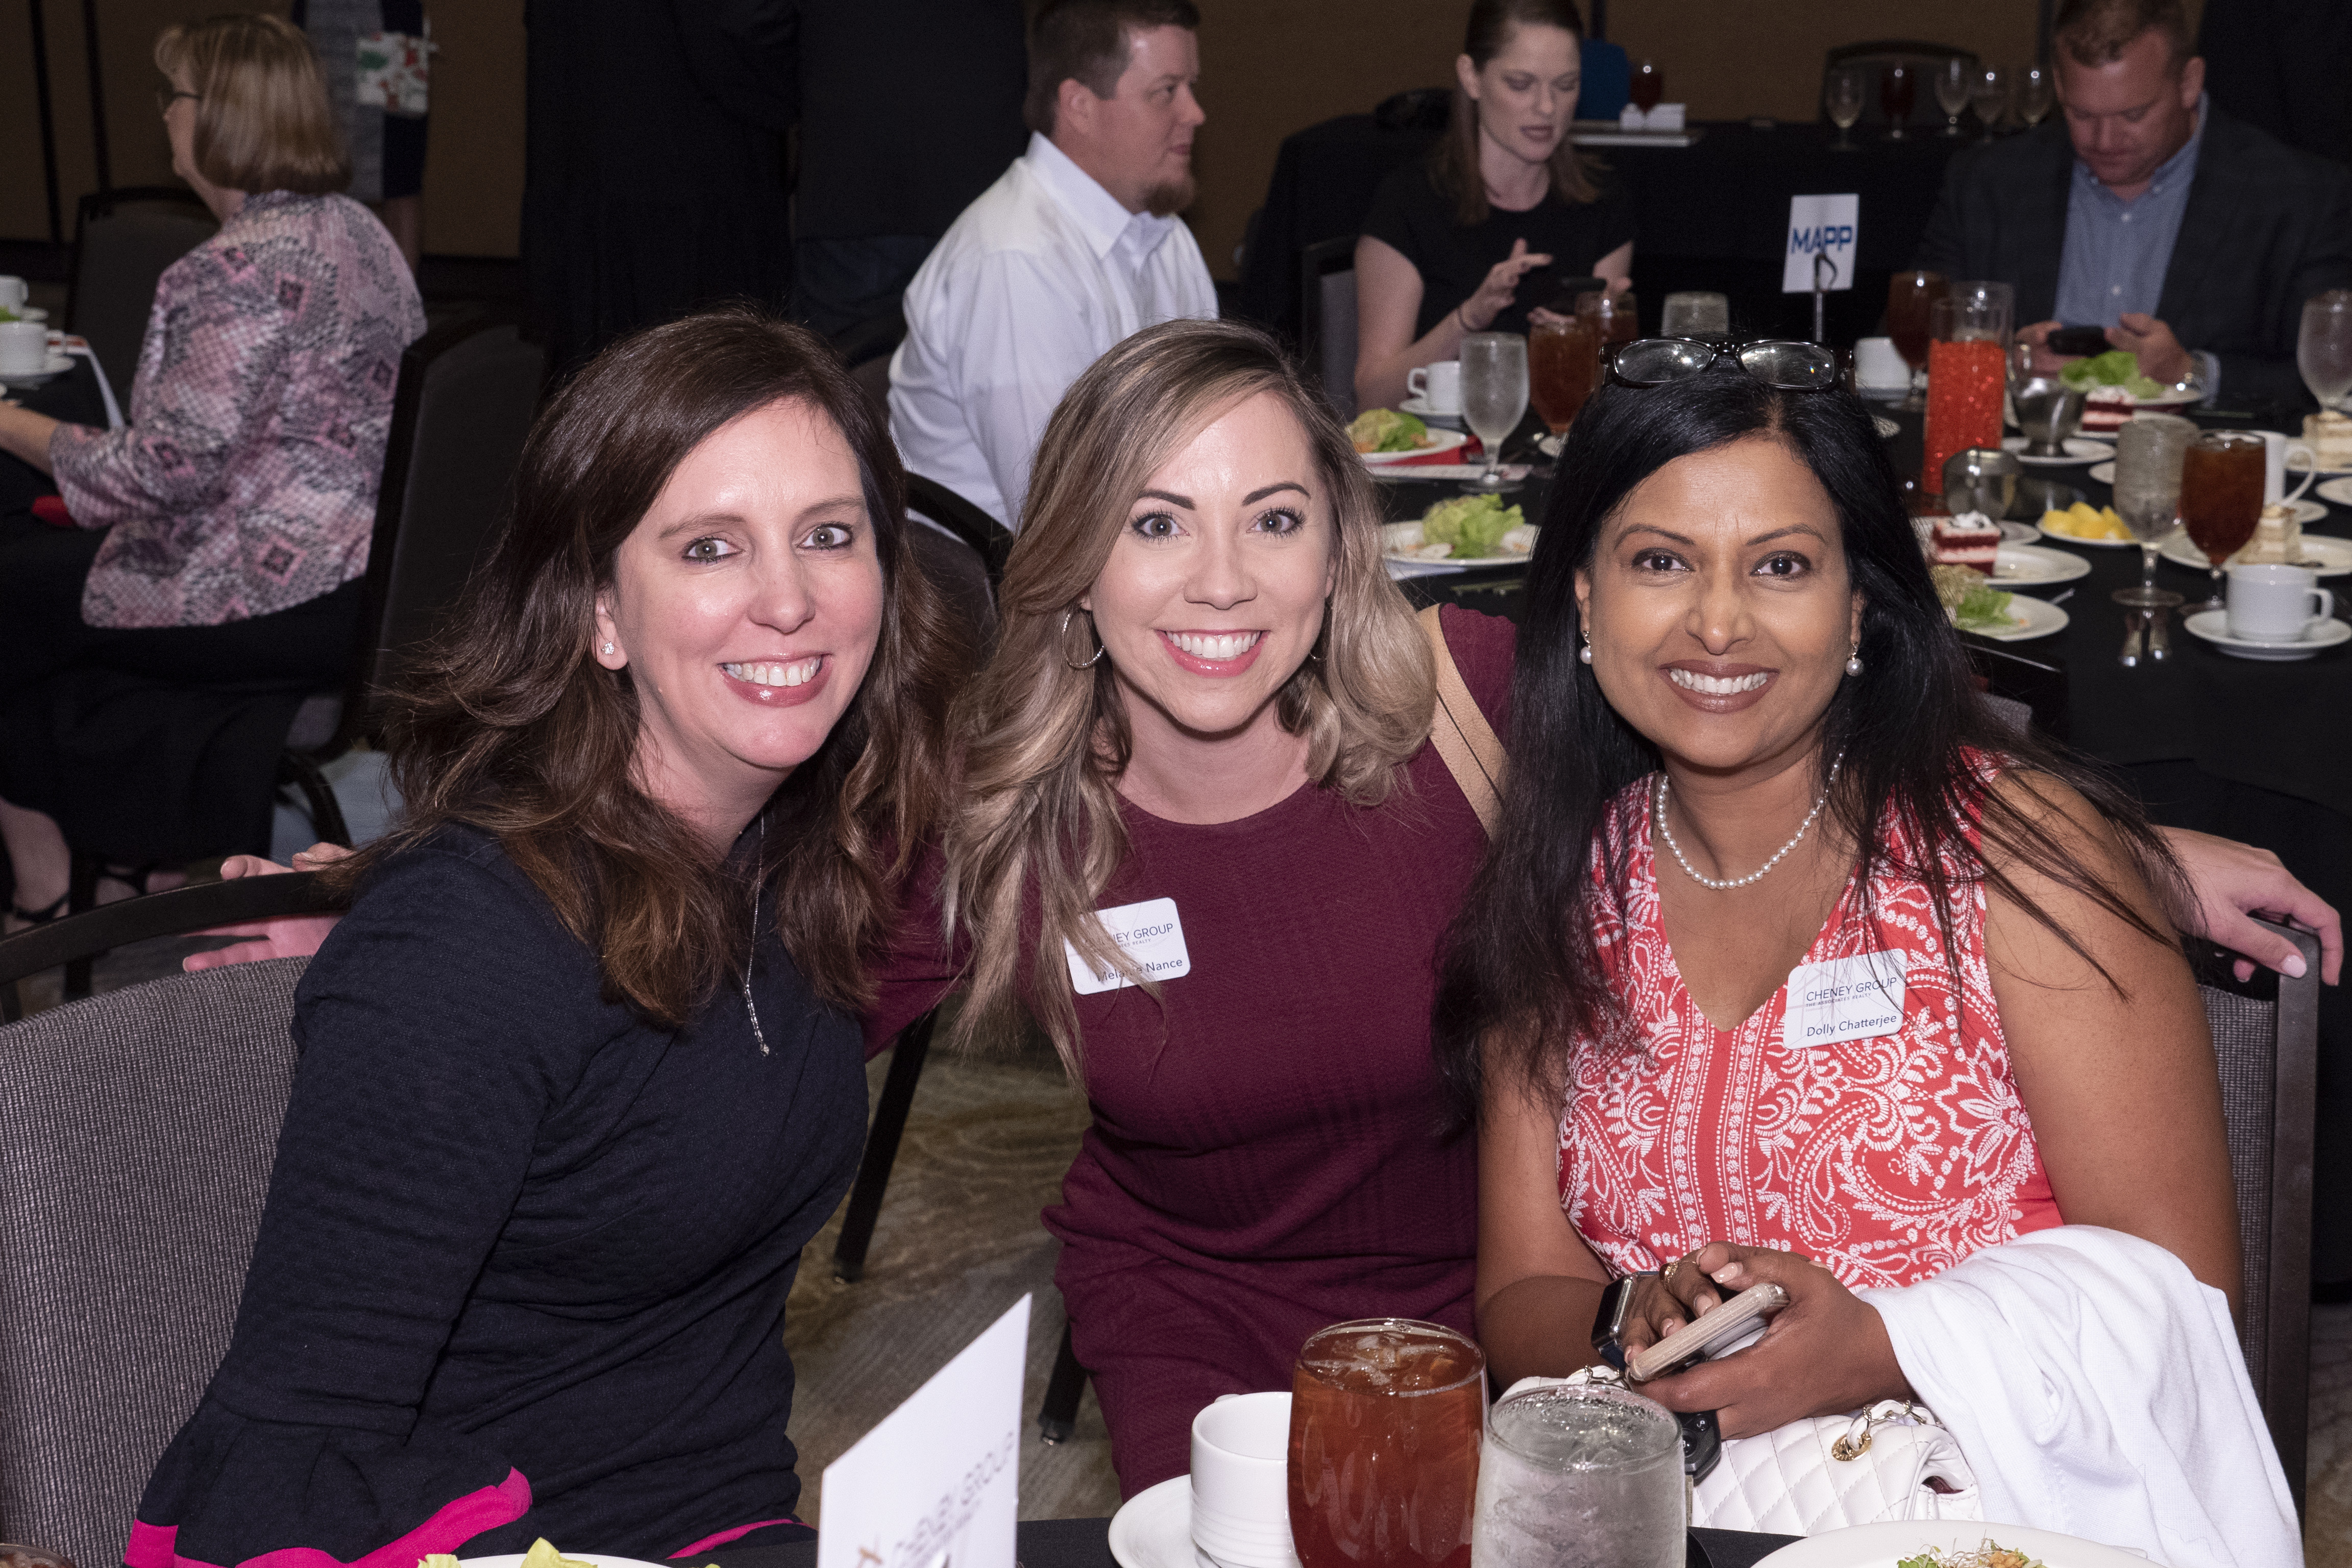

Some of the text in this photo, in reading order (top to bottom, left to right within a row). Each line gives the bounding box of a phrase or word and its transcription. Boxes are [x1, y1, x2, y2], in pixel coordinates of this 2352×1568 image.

[1791, 225, 1853, 253] MAPP
[1134, 923, 1173, 939] GROUP
[1146, 959, 1183, 972] Nance
[1806, 977, 1897, 1001] CHENEY GROUP
[1818, 996, 1850, 1005] ASSOCIATES
[1807, 1015, 1897, 1037] Dolly Chatterjee
